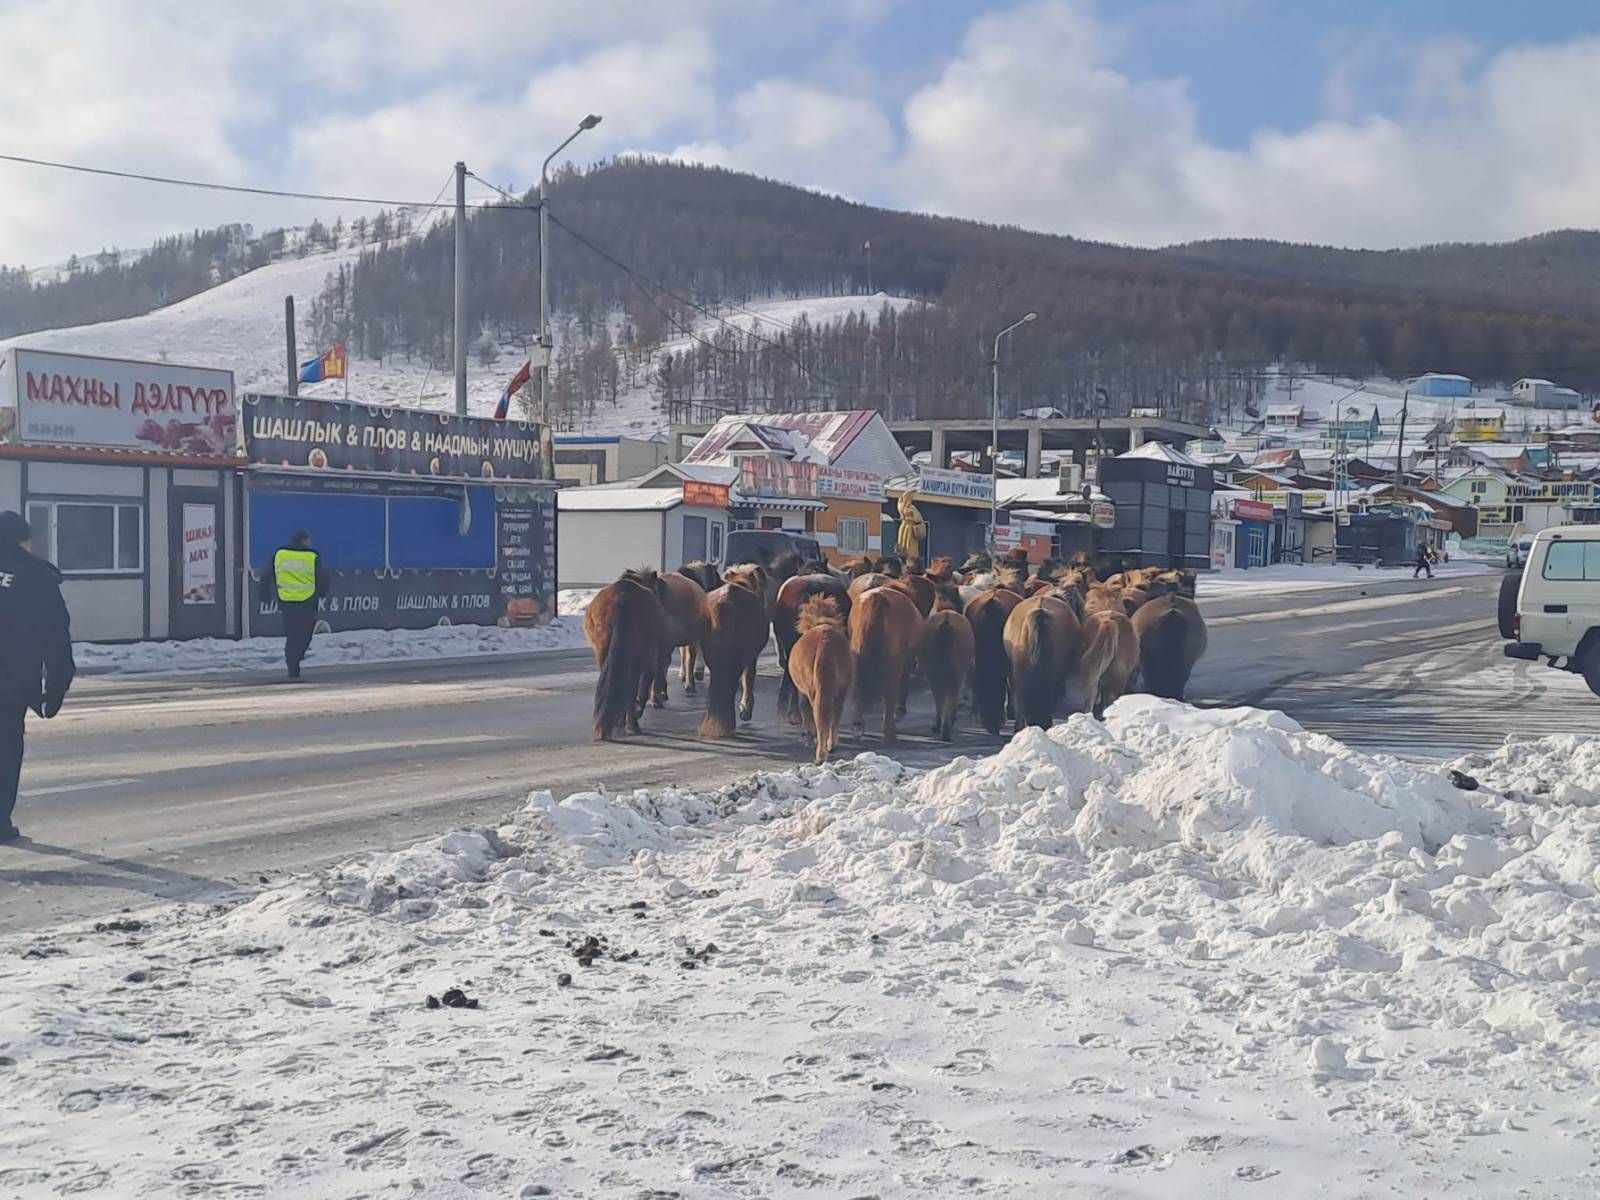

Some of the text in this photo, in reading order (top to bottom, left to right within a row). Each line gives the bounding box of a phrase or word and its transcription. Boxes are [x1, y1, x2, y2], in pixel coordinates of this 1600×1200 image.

[26, 371, 120, 408] МАХНЫ
[253, 416, 342, 444] ШАШЛЫК
[346, 424, 358, 446] &
[362, 426, 406, 449] ПЛОВ
[411, 431, 421, 451] &
[425, 432, 490, 458] НААДМЫН
[1551, 483, 1591, 496] ШОРЛОГ
[189, 548, 208, 562] МАХ
[330, 598, 339, 611] &
[343, 596, 379, 611] ПЛОВ
[396, 594, 490, 609] ШАШЛЫК & ПЛОВ
